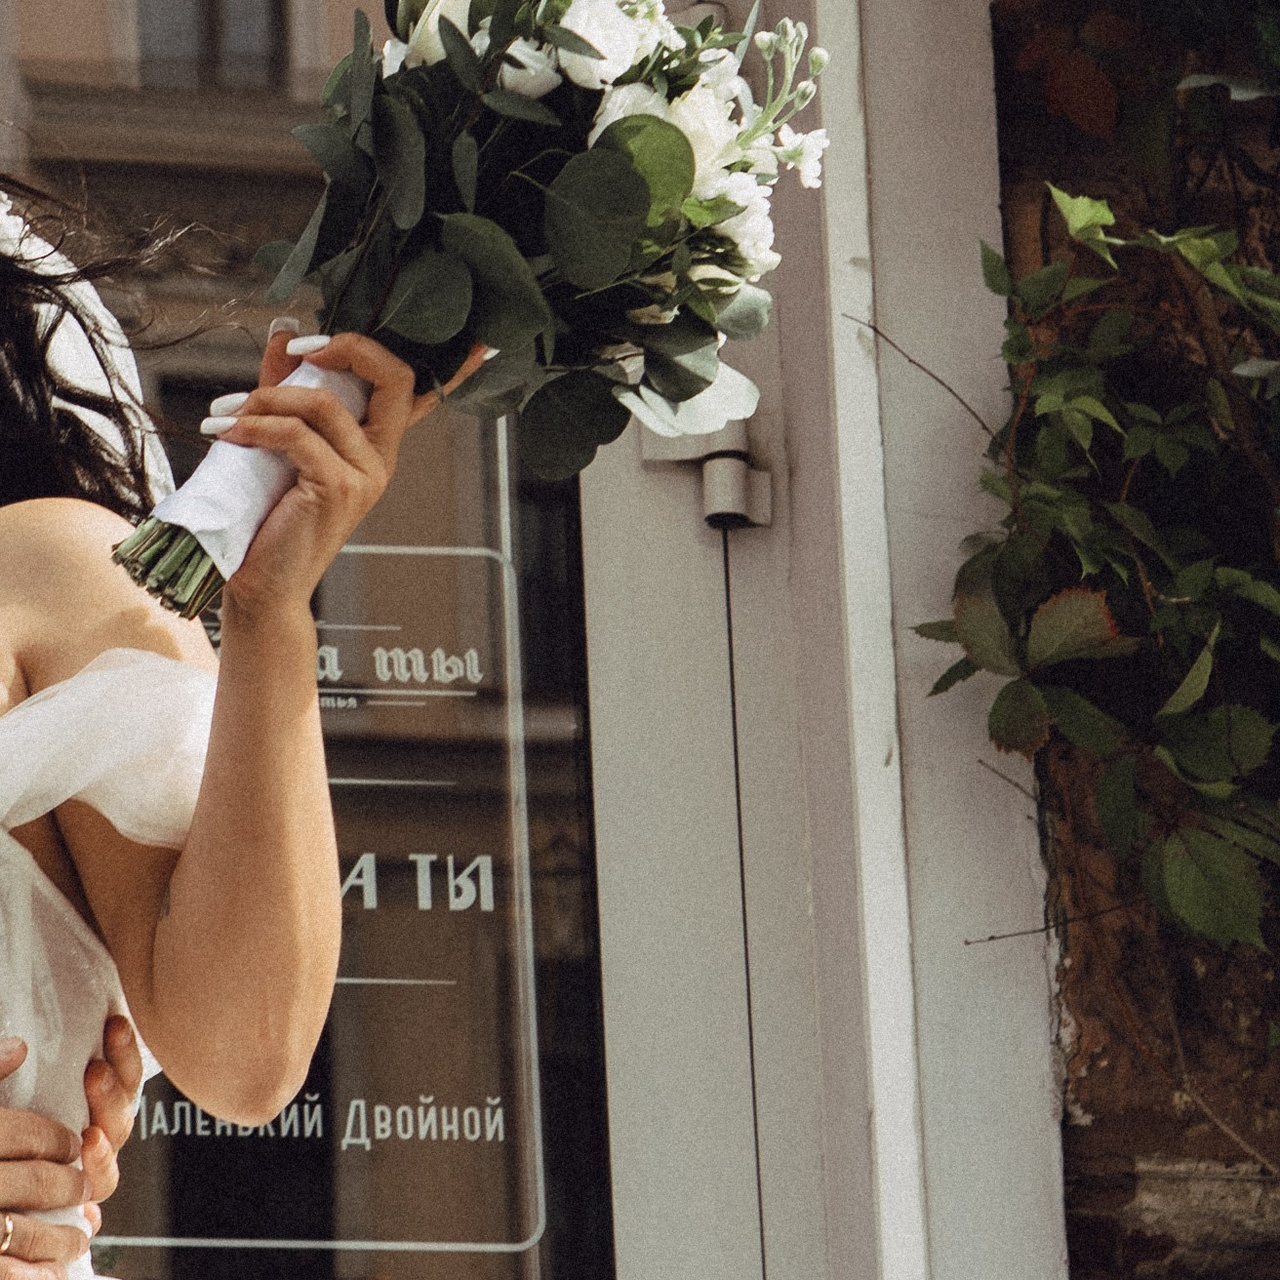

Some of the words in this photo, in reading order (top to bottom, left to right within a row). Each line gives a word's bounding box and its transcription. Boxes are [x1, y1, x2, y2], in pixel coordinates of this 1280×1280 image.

[317, 644, 343, 682] а
[341, 853, 377, 910] А
[408, 852, 495, 912] ТЫ
